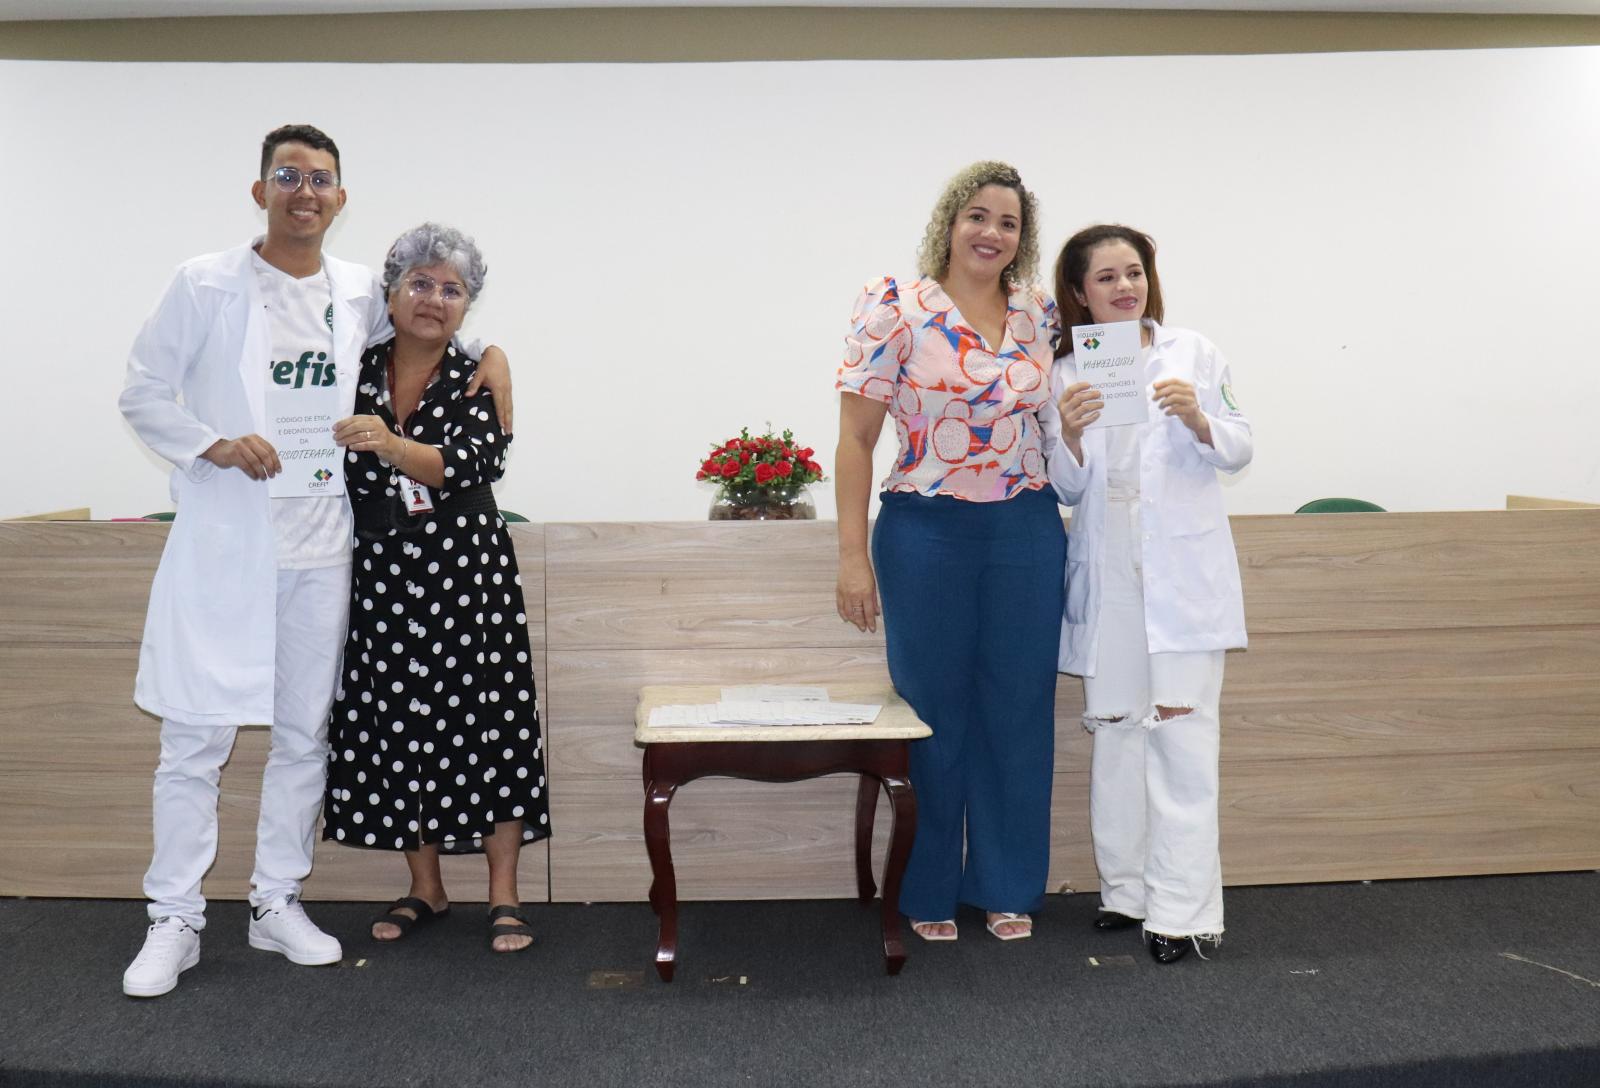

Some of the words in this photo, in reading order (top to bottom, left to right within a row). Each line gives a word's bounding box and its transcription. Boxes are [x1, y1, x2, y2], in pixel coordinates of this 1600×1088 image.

[1083, 356, 1135, 369] FISIOTERAPIA
[283, 427, 330, 435] DEONTOLOGIA
[278, 448, 336, 461] FISIOTERAPIA
